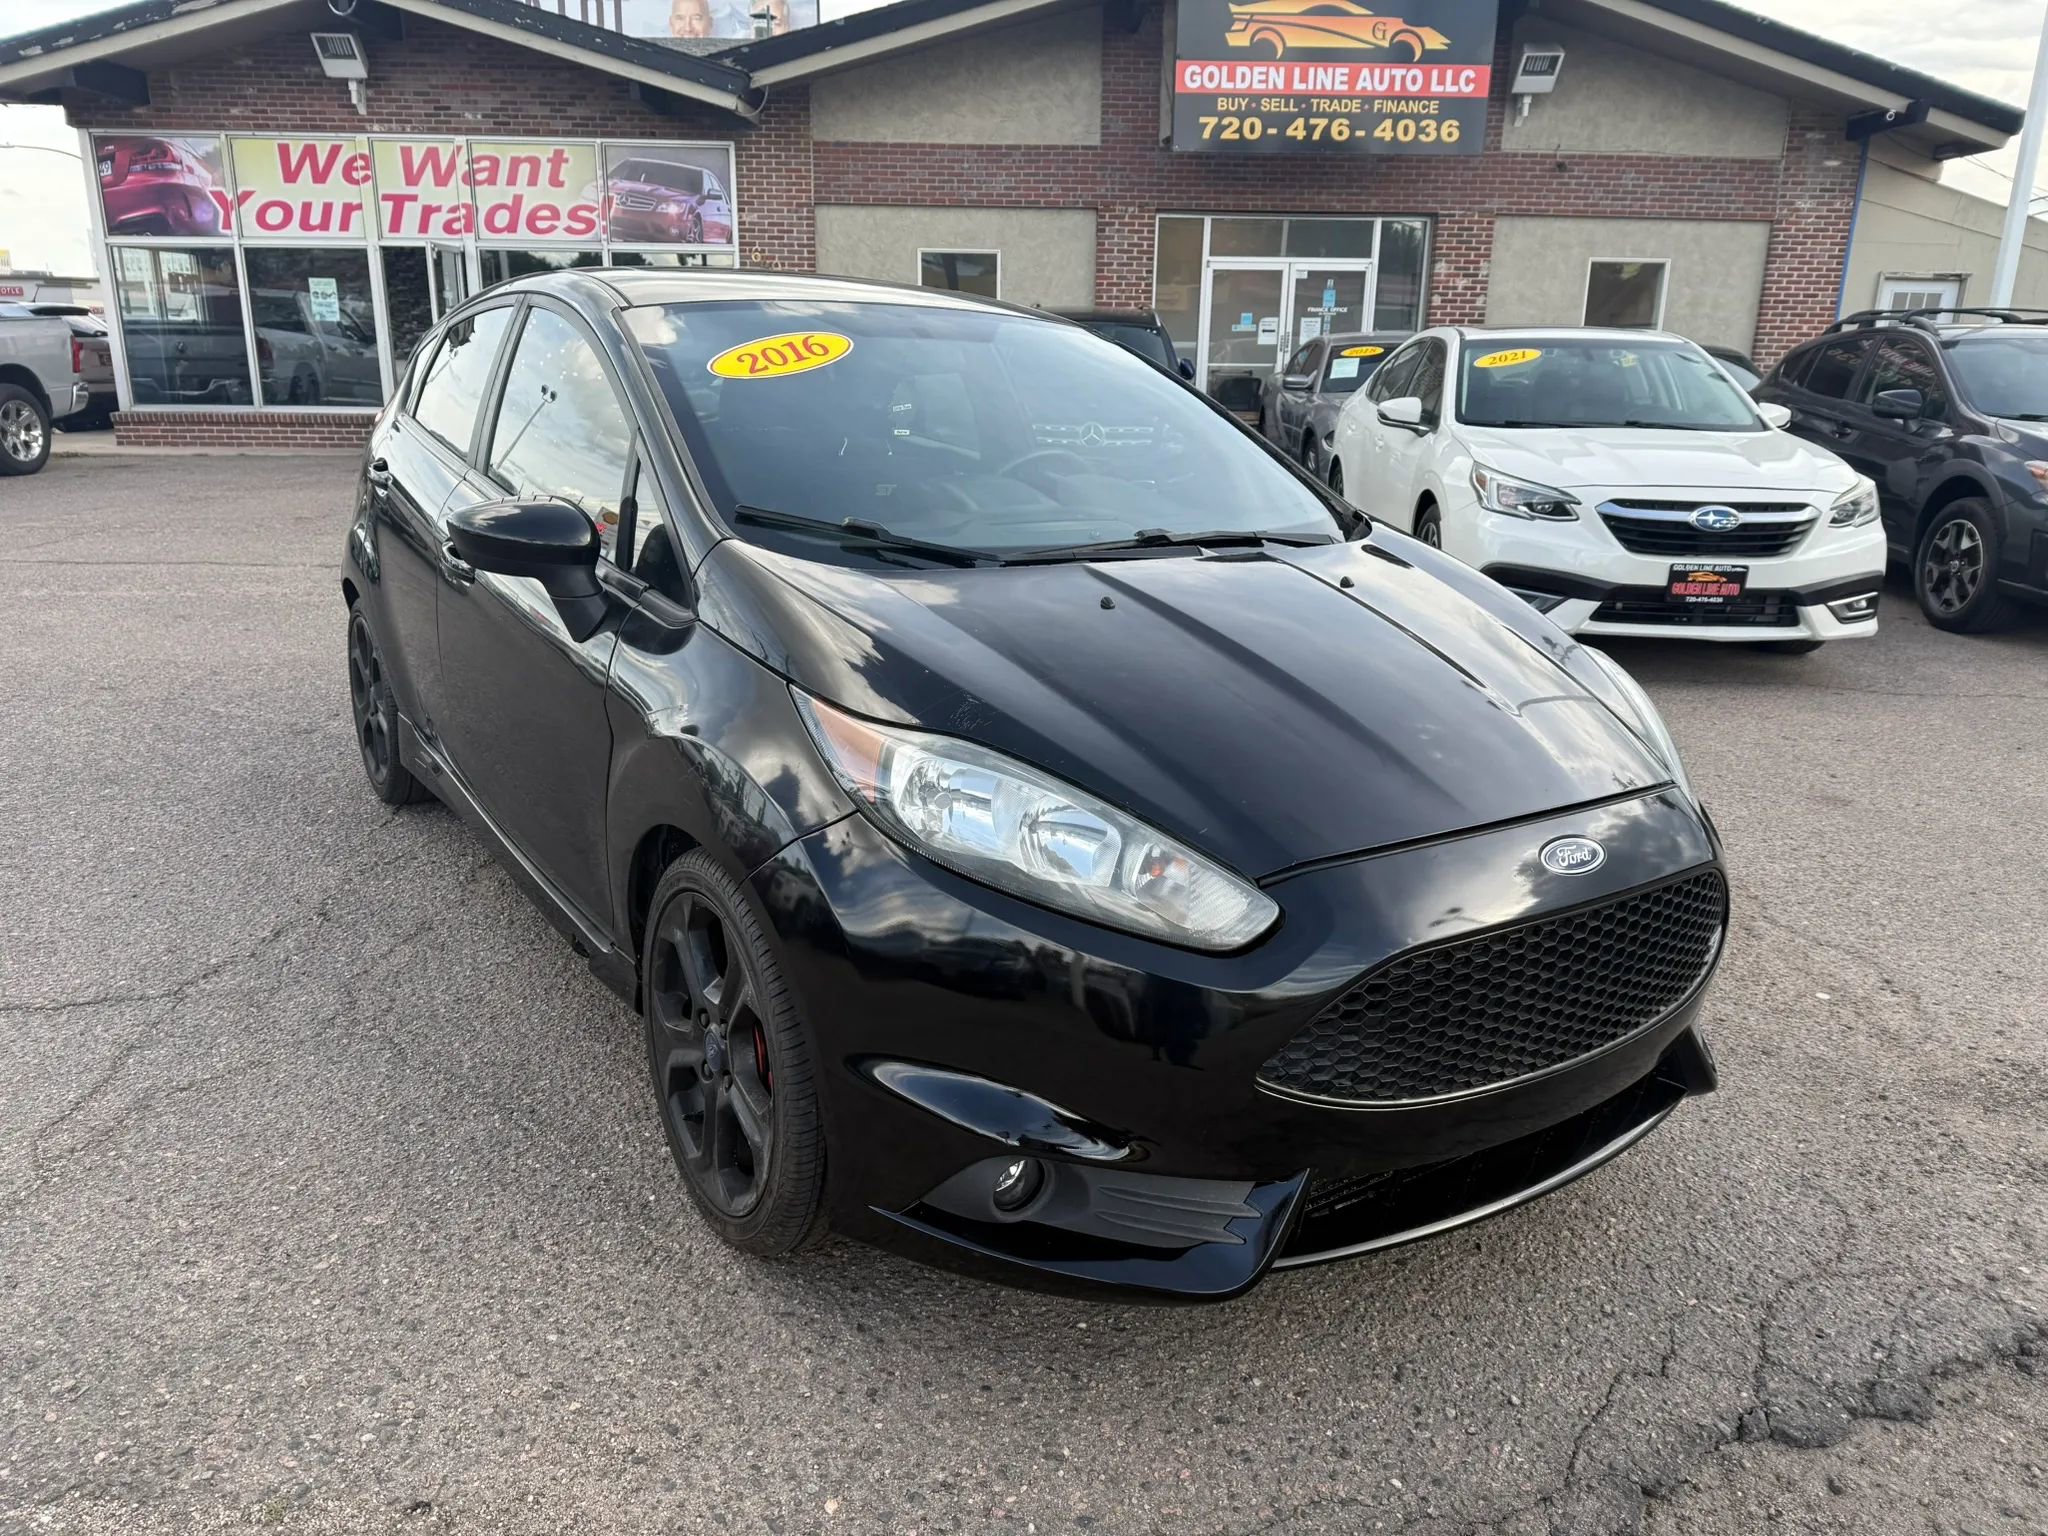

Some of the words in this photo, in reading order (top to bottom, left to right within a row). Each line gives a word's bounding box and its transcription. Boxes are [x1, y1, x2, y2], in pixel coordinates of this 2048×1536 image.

[1183, 64, 1285, 91] GOLDEN
[1292, 65, 1350, 92] LINE
[1355, 67, 1424, 93] AUTO
[1430, 68, 1477, 94] LLC
[1217, 97, 1249, 112] BUY
[1260, 98, 1299, 113] SELL
[1310, 98, 1362, 113] TRADE
[1373, 99, 1440, 115] FINANCE
[276, 142, 372, 186] We
[399, 145, 570, 188] Want
[209, 189, 363, 232] Your
[735, 334, 830, 375] 2016
[1488, 350, 1528, 366] 2021
[1672, 564, 1699, 572] GOLDEN
[1699, 564, 1713, 572] LINE
[1671, 582, 1701, 595] GOLDEN
[1556, 845, 1592, 867] Ford
